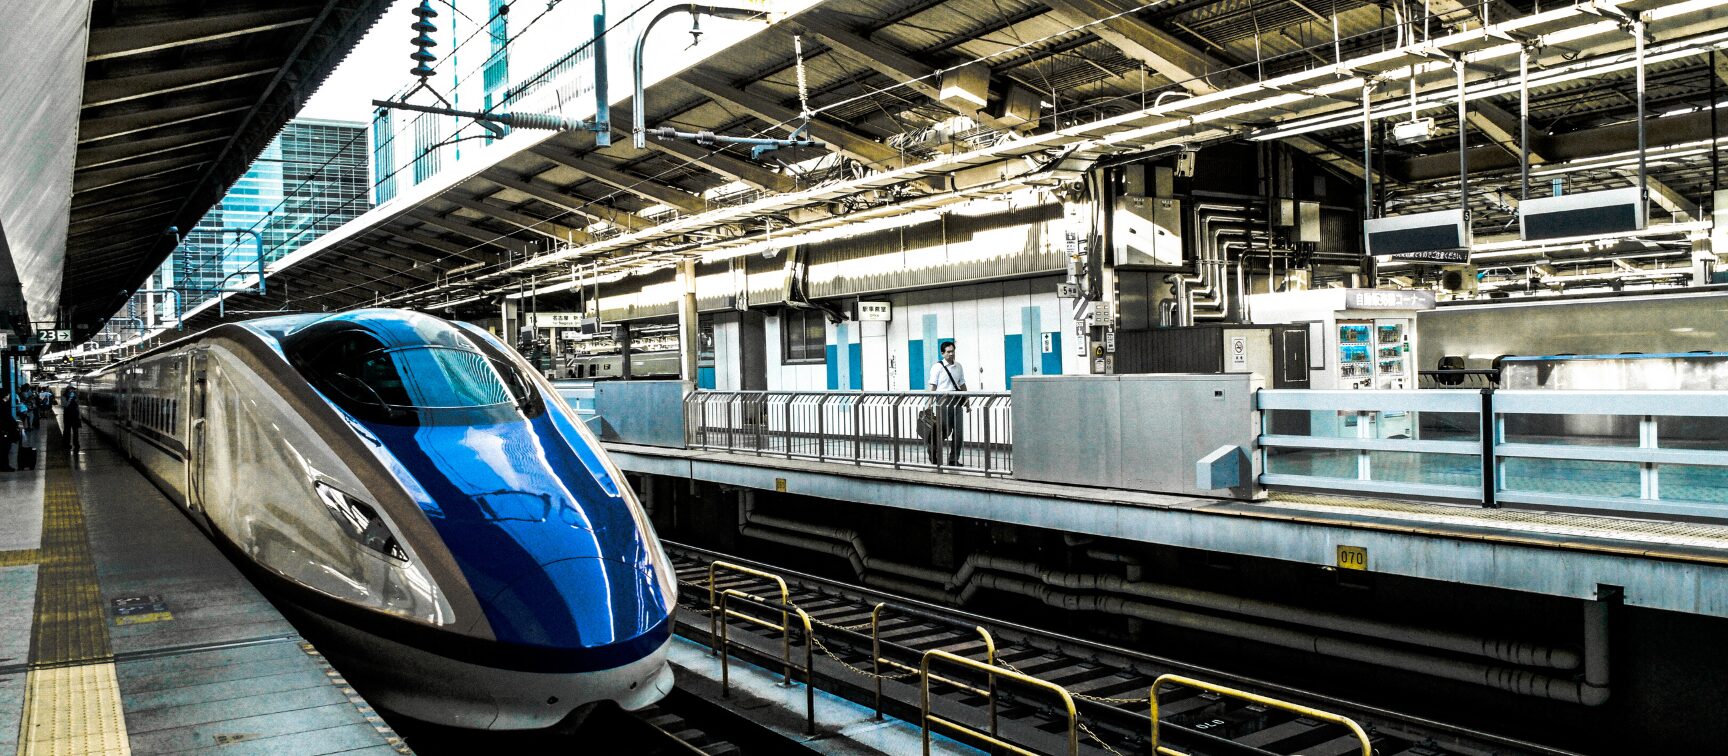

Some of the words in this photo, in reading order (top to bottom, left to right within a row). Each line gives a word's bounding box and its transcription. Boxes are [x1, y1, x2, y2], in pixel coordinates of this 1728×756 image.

[1643, 190, 1648, 200] 4
[1464, 212, 1469, 221] 5
[39, 330, 56, 341] 23
[1341, 550, 1363, 565] 070
